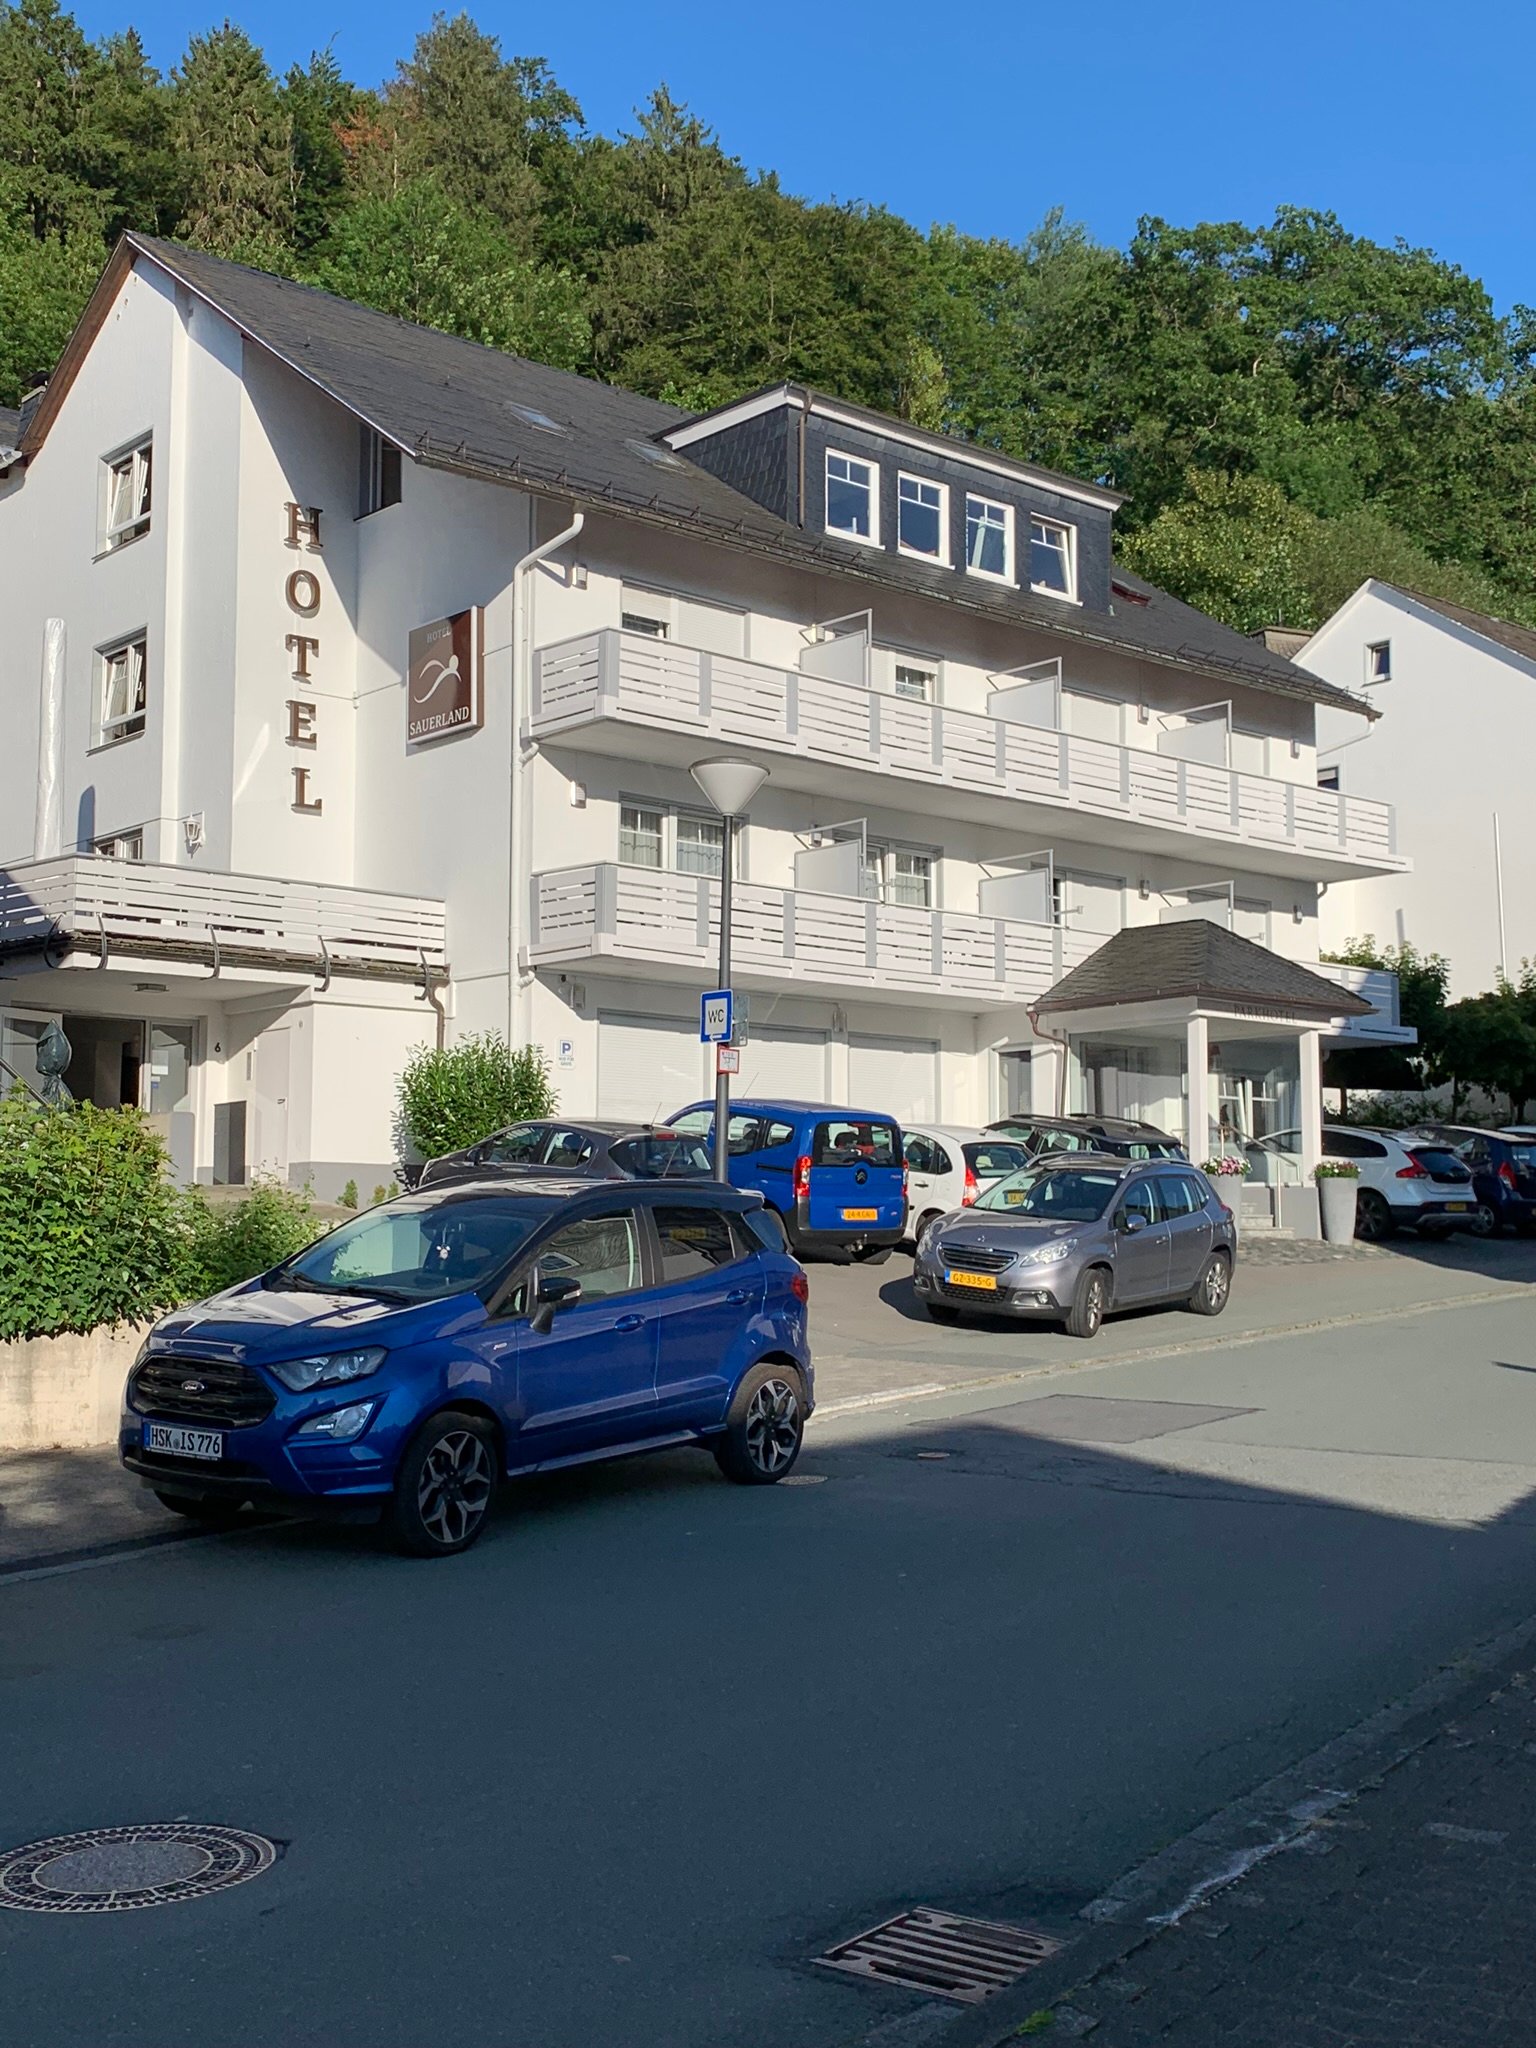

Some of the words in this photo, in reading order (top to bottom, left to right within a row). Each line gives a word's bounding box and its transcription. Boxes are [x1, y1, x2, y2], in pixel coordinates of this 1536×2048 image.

[426, 626, 452, 643] HOTEL
[284, 501, 323, 817] HOTEL
[409, 706, 470, 736] SAUERLAND
[708, 1009, 725, 1024] WC
[1234, 1004, 1297, 1024] PARKHOTEL
[214, 1042, 221, 1053] 6
[562, 1042, 571, 1055] P
[952, 1272, 992, 1288] GZ-335-G
[151, 1427, 172, 1447] HSK
[180, 1431, 195, 1452] IS
[197, 1433, 220, 1455] 776
